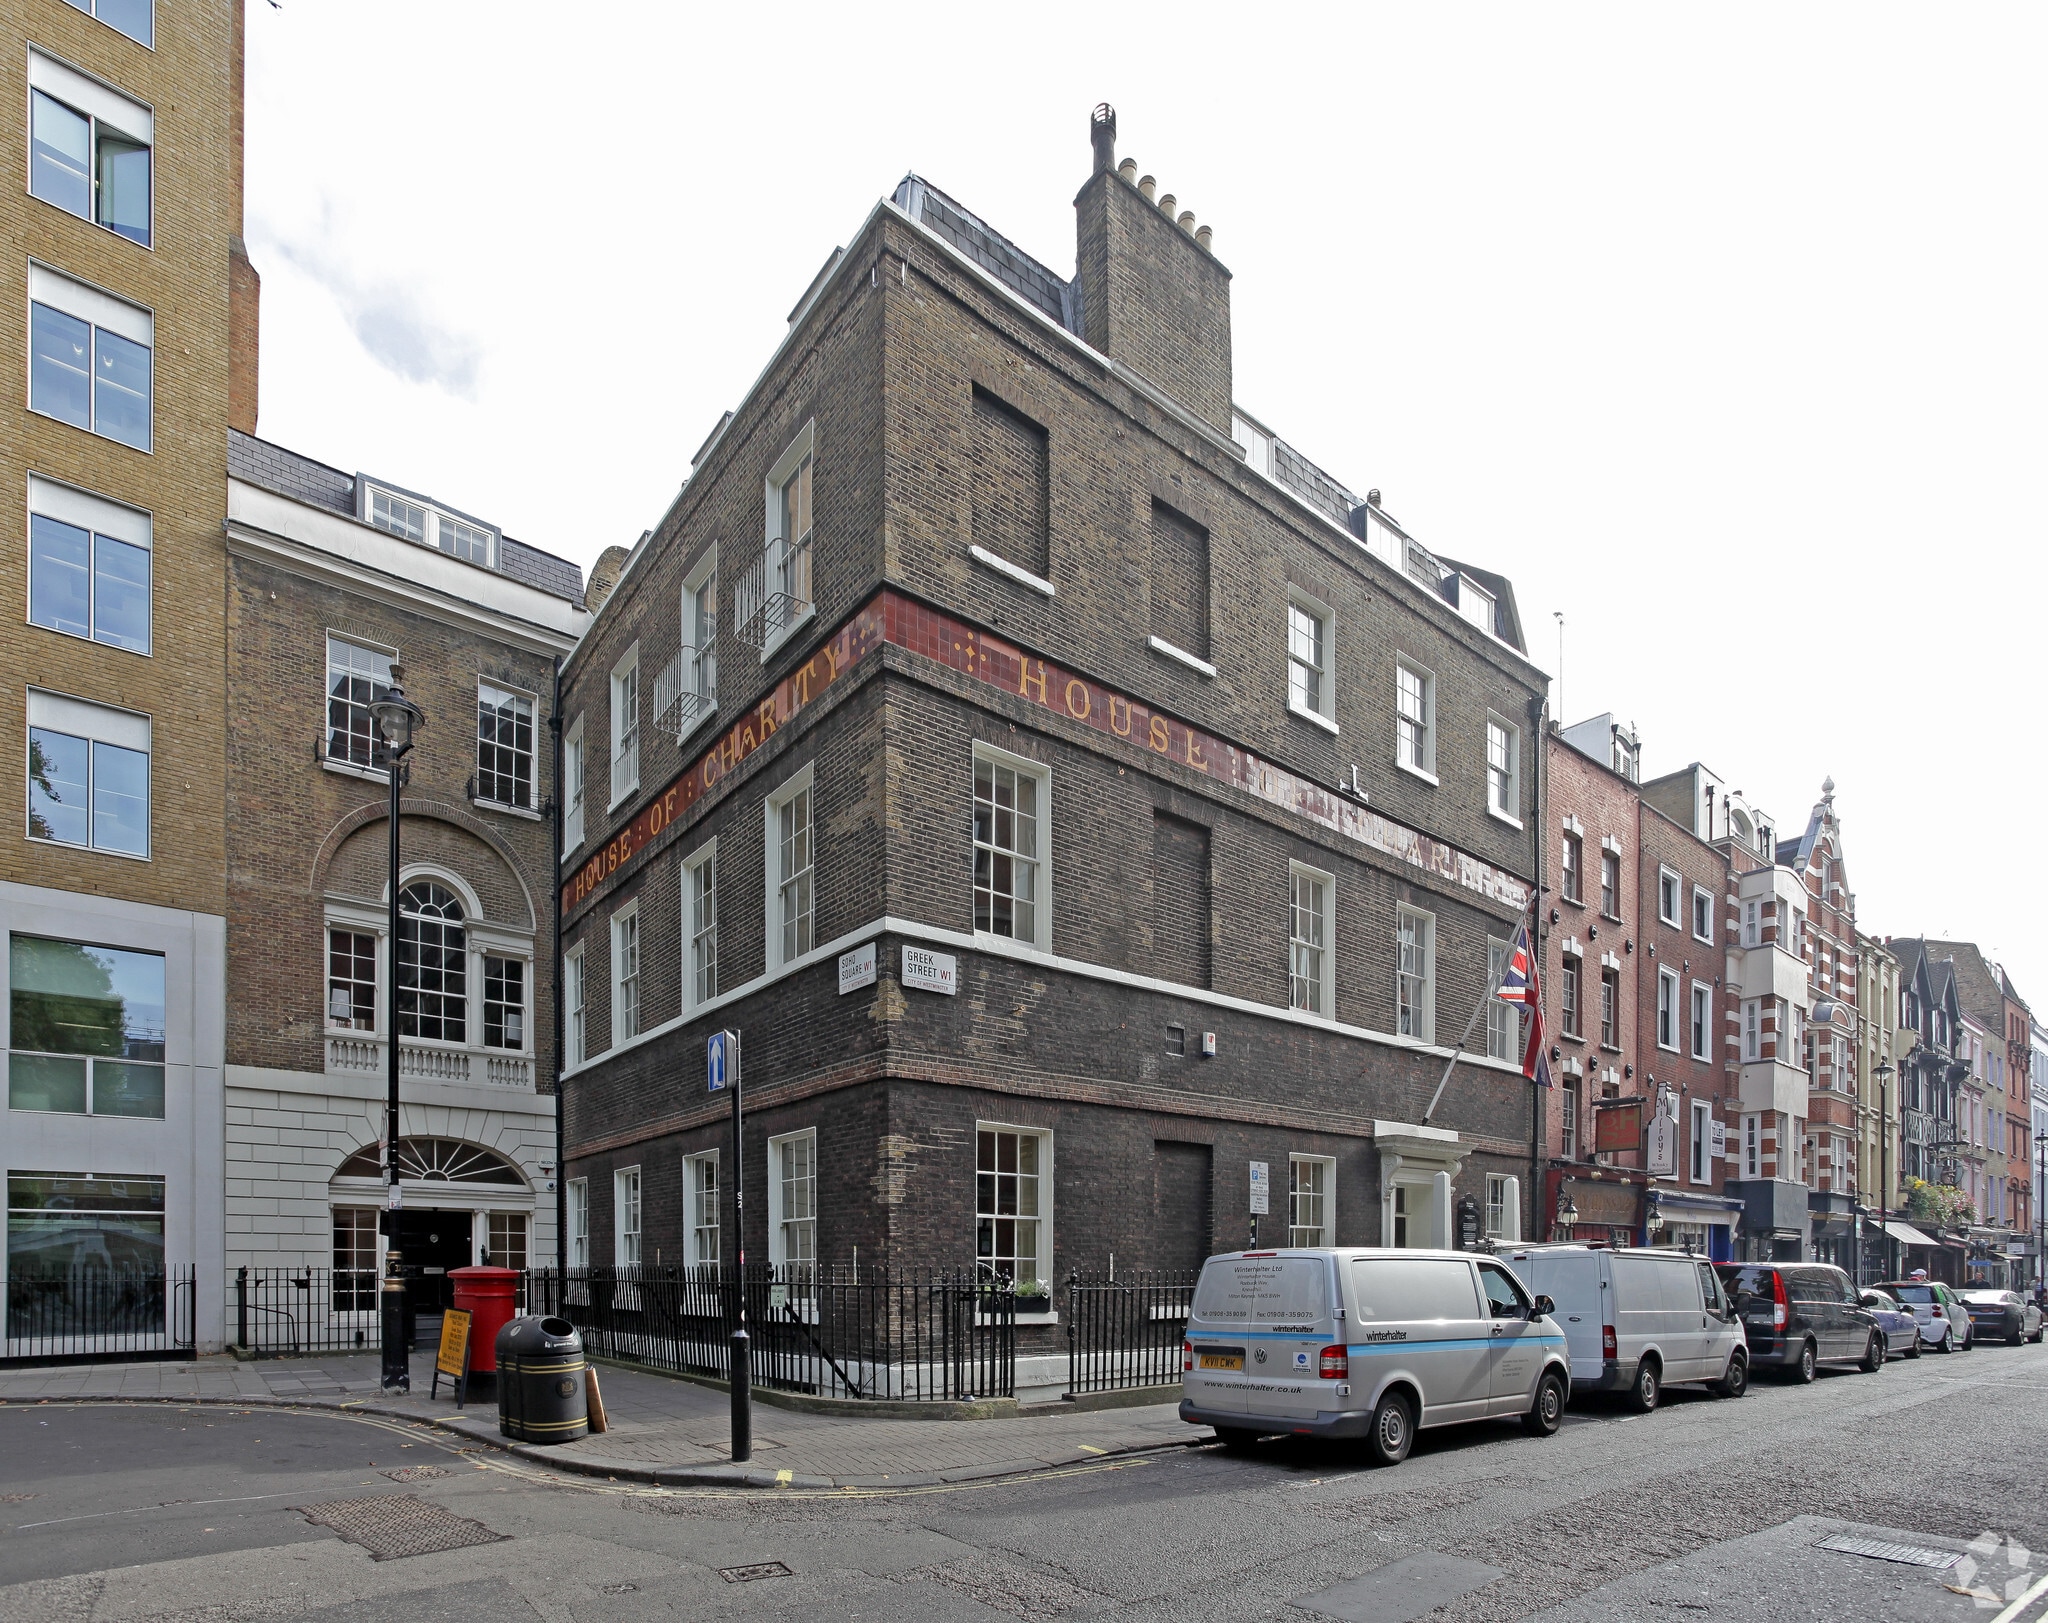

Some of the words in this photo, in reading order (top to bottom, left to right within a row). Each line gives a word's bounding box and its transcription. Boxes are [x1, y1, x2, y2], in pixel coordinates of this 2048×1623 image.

[1018, 654, 1209, 772] HOUSE
[574, 828, 634, 898] HOUSE
[649, 788, 679, 836] OF
[841, 954, 856, 969] SOHO
[907, 950, 934, 965] GREEK
[841, 963, 863, 981] SQUARE
[863, 959, 872, 972] W1
[907, 962, 938, 978] STREET
[939, 969, 951, 981] W1
[1272, 1325, 1315, 1334] winterhalter
[1365, 1329, 1407, 1342] winterhalter
[1204, 1356, 1219, 1367] KV11
[1203, 1380, 1303, 1394] www.winterhalter.co.uk
